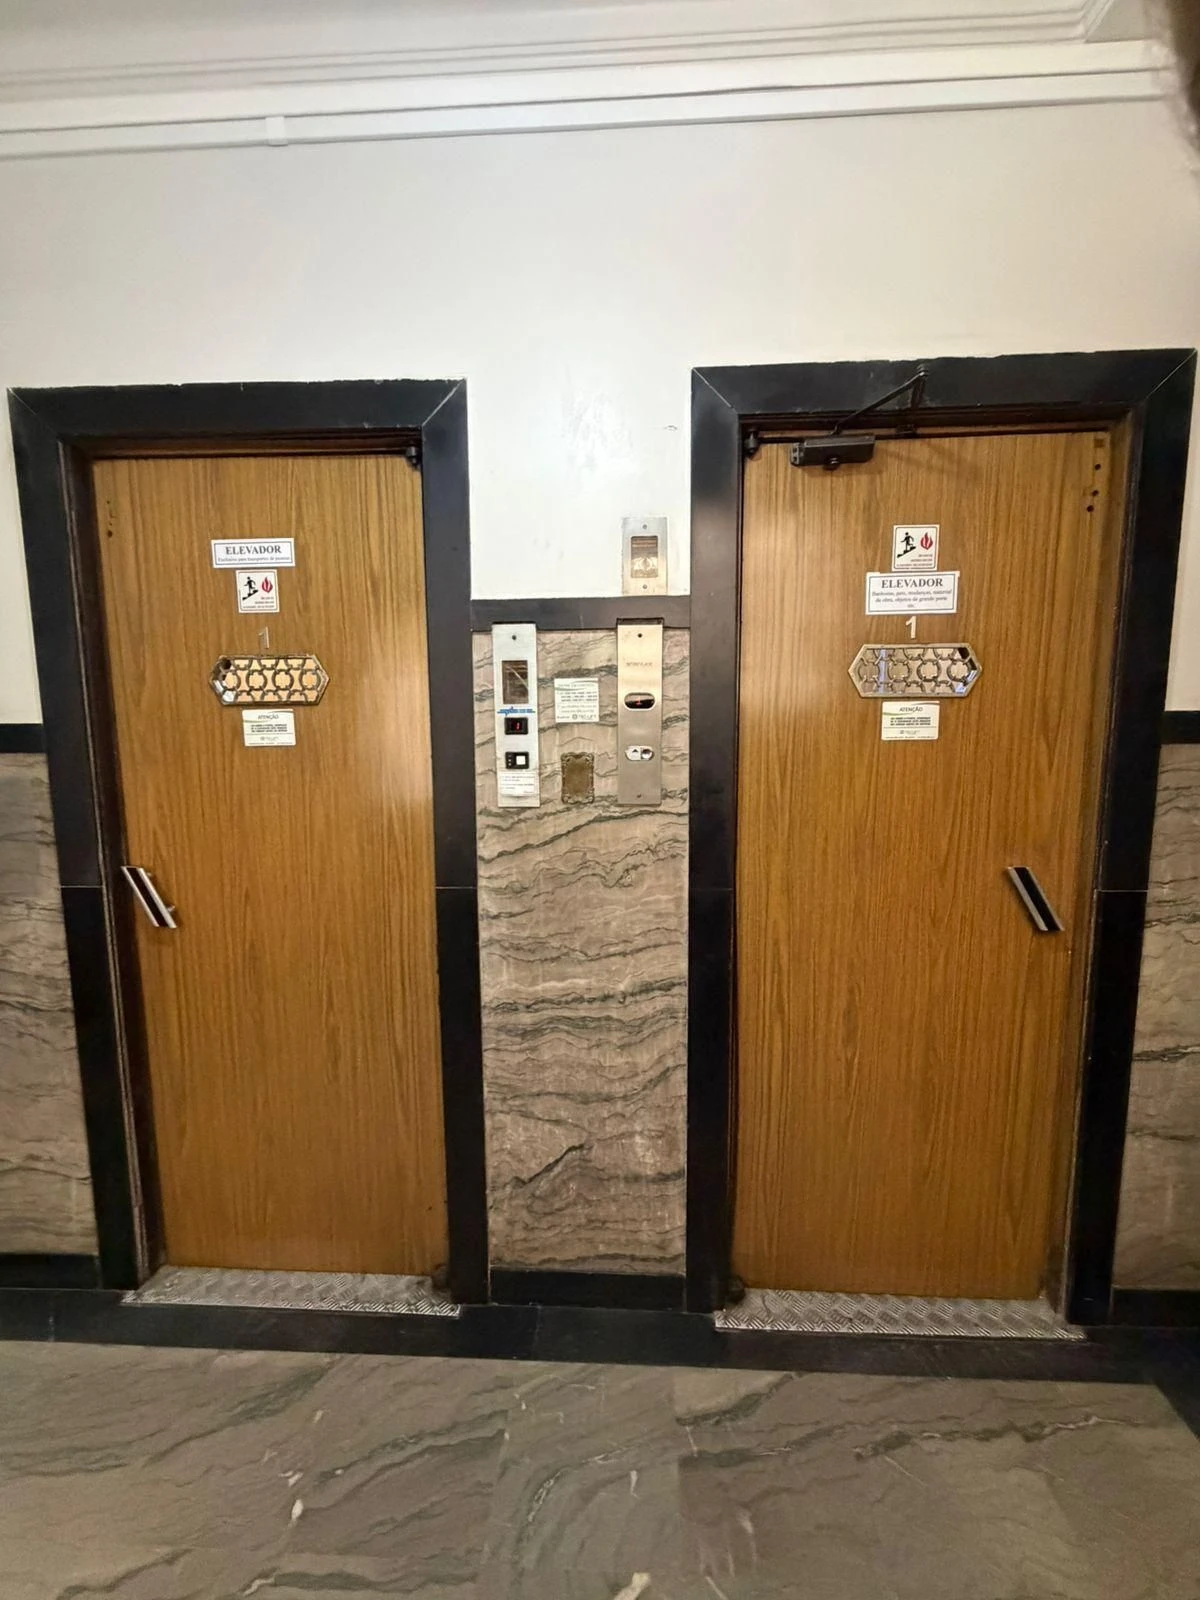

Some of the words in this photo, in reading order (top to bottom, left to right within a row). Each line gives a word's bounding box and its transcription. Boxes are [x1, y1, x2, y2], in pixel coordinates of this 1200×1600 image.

[225, 545, 282, 555] ELEVADOR
[881, 578, 943, 589] ELEVADOR
[905, 615, 917, 639] 1
[258, 626, 270, 649] 1
